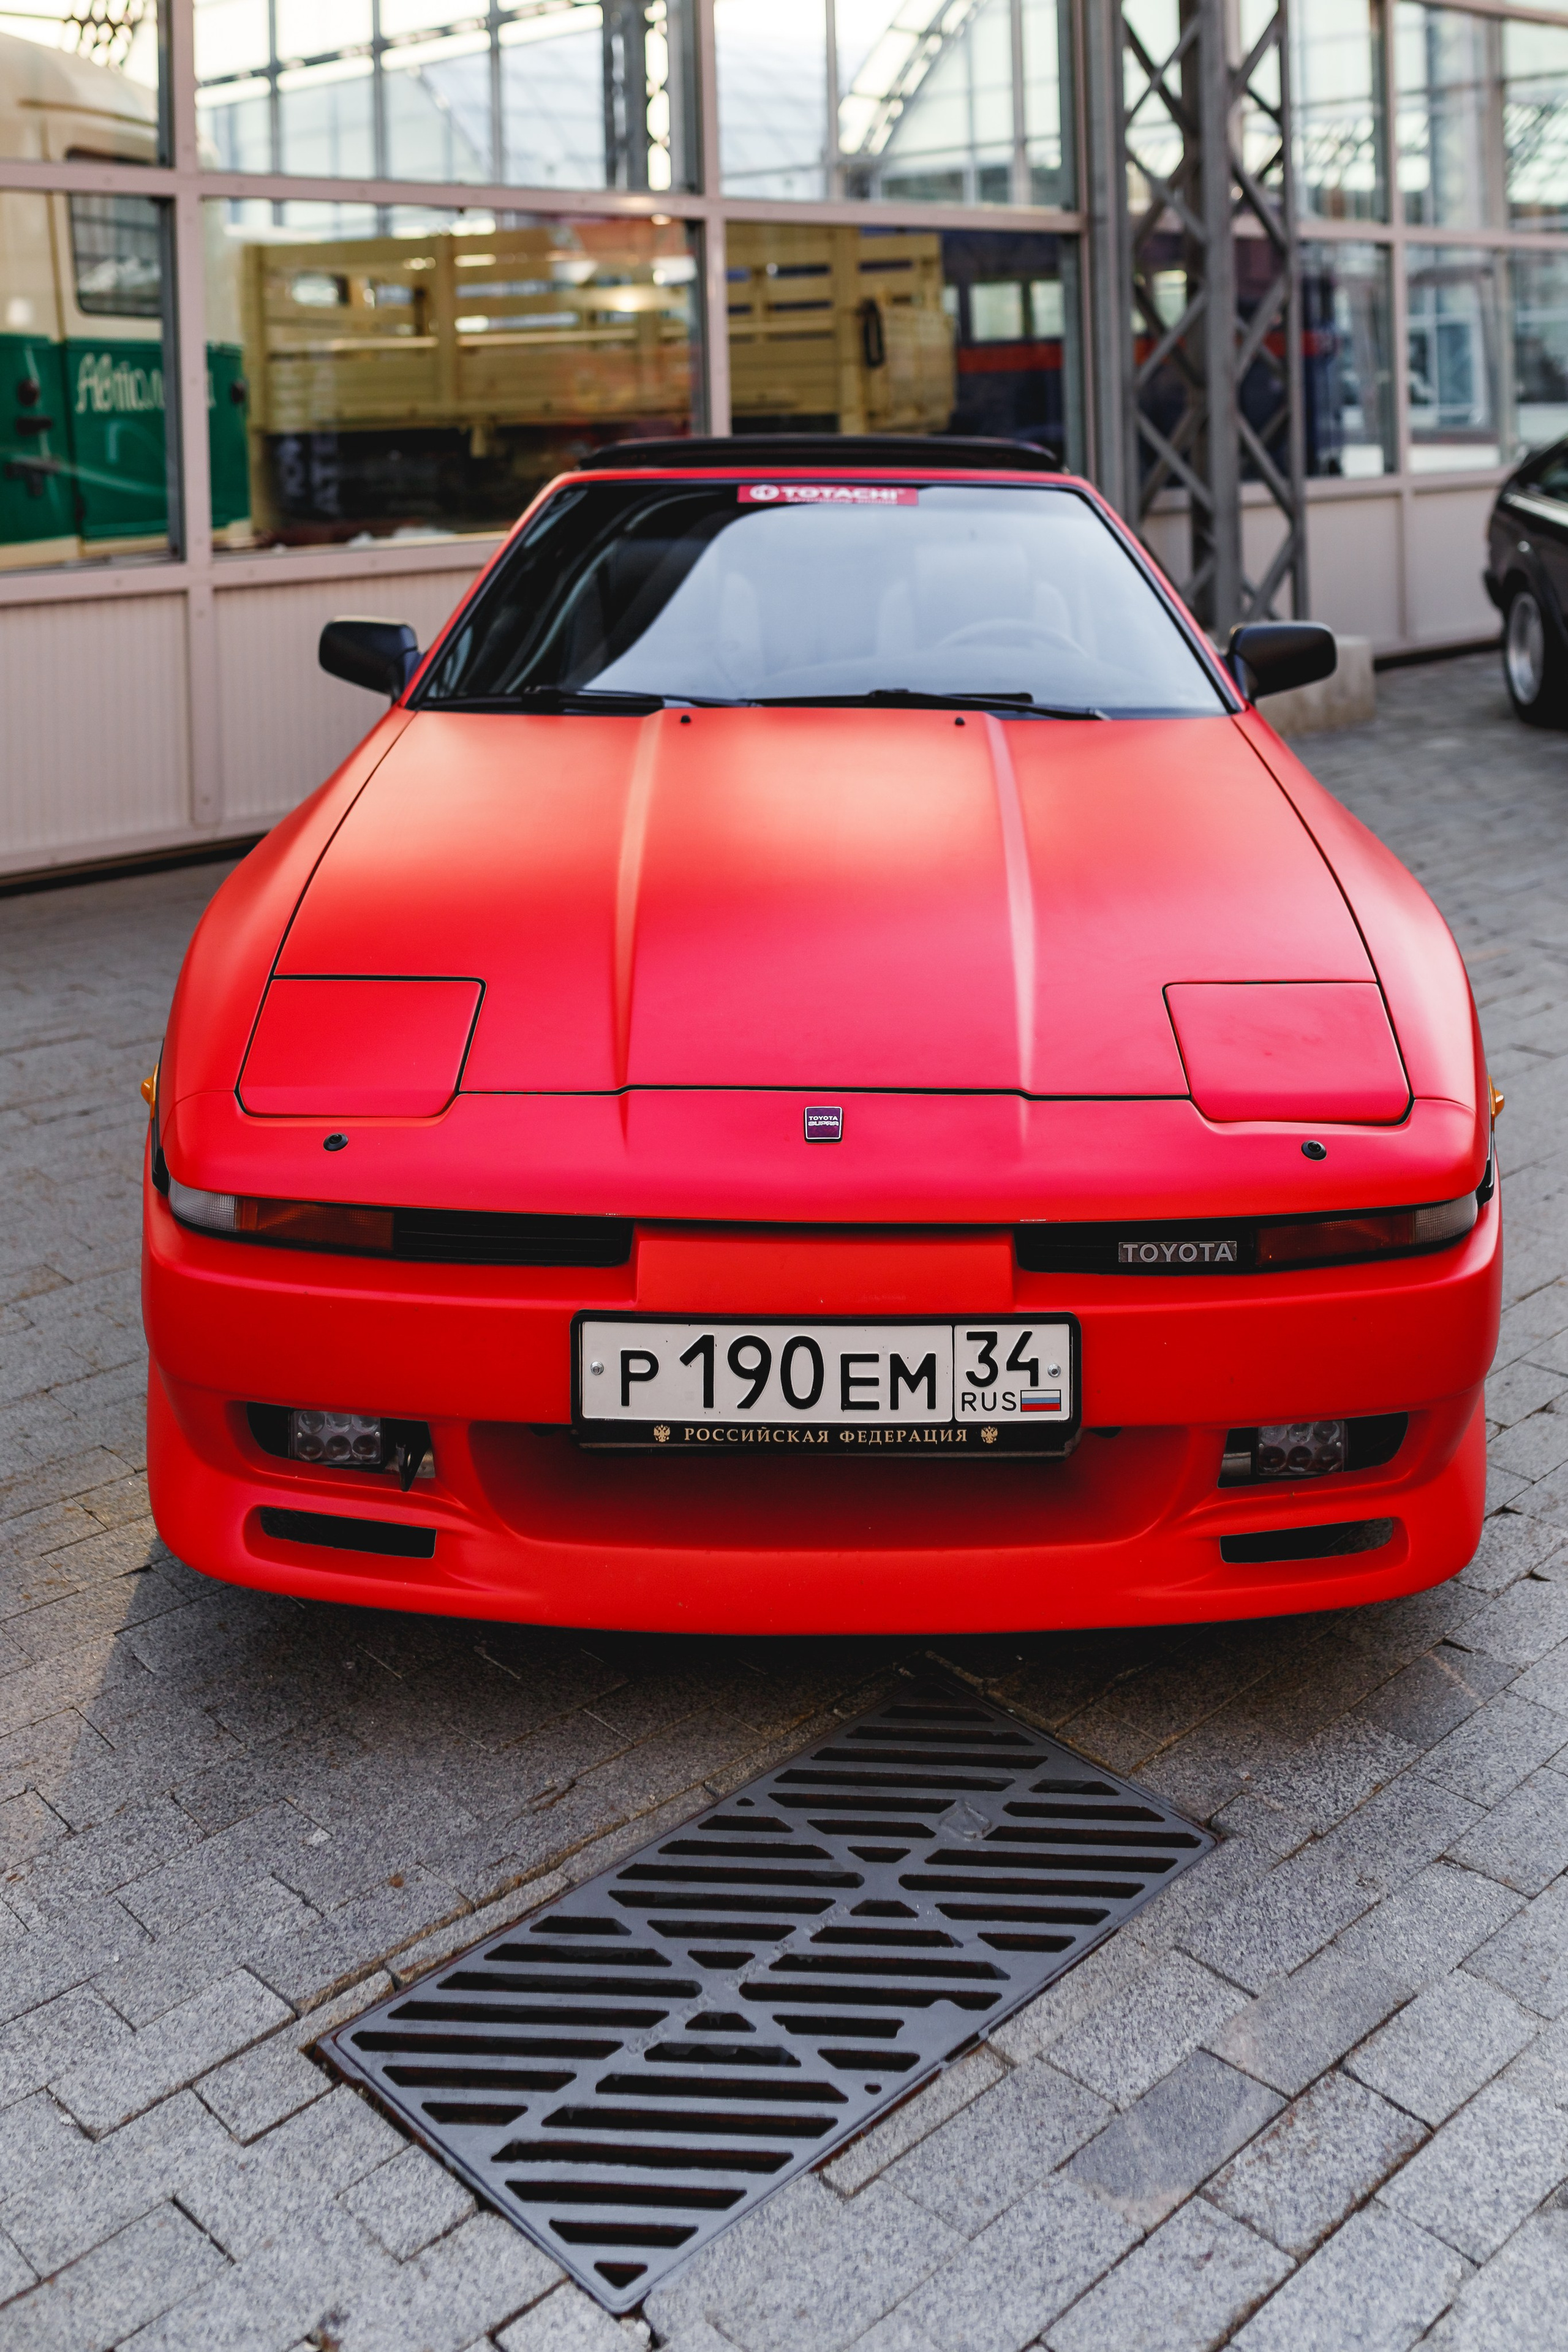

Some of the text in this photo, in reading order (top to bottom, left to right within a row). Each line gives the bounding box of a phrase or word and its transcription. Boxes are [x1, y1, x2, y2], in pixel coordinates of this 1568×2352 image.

[781, 486, 898, 500] TOTACHI
[1123, 1243, 1234, 1262] TOYOTA
[965, 1331, 1039, 1388] 34
[961, 1391, 1017, 1412] RUS
[684, 1426, 968, 1446] РОССИЙСКАЯ ФЕДЕРАЦИЯ
